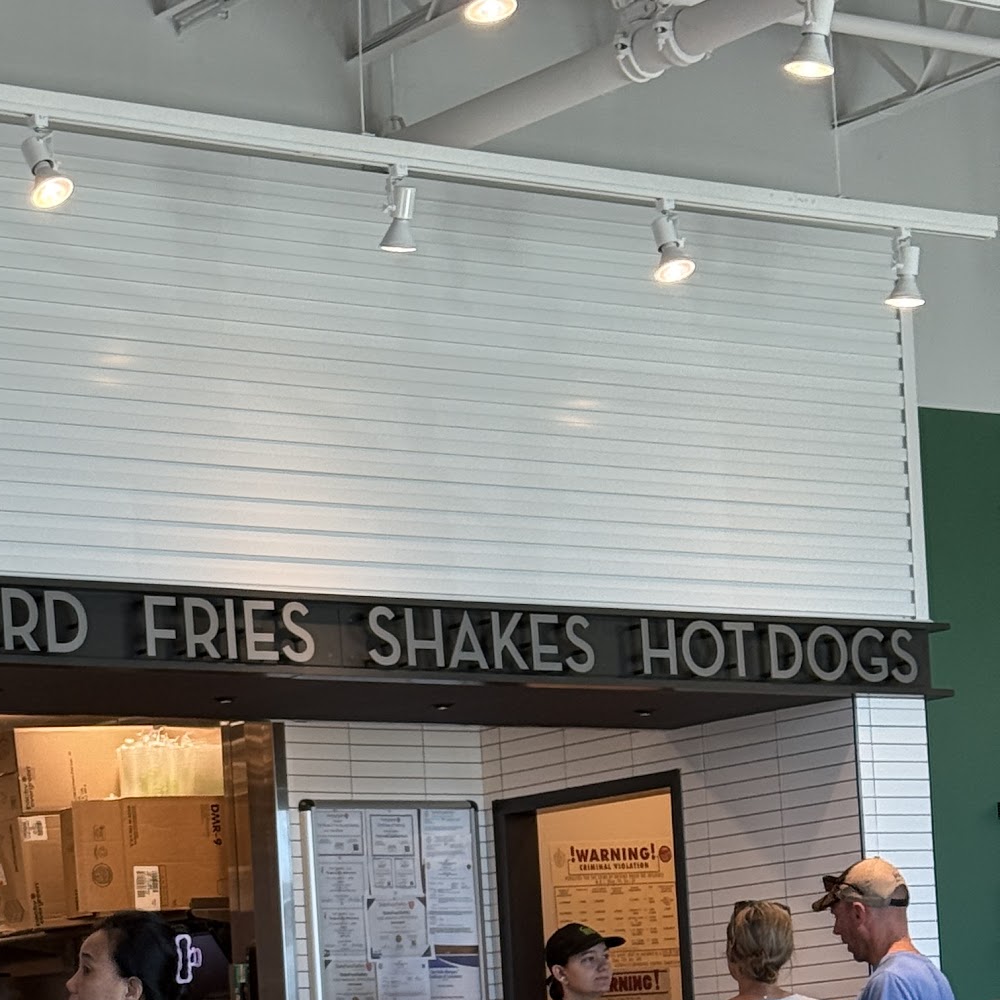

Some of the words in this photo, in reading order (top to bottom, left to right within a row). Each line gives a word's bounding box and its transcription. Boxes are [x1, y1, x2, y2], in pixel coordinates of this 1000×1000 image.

[143, 595, 315, 663] FRIES
[368, 606, 595, 673] SHAKES
[640, 618, 755, 678] HOT
[768, 623, 919, 684] DOGS
[210, 803, 222, 846] DMR-9
[570, 843, 656, 863] !WARNING!
[579, 863, 612, 871] CRIMINAL
[613, 862, 649, 870] VIOLATION
